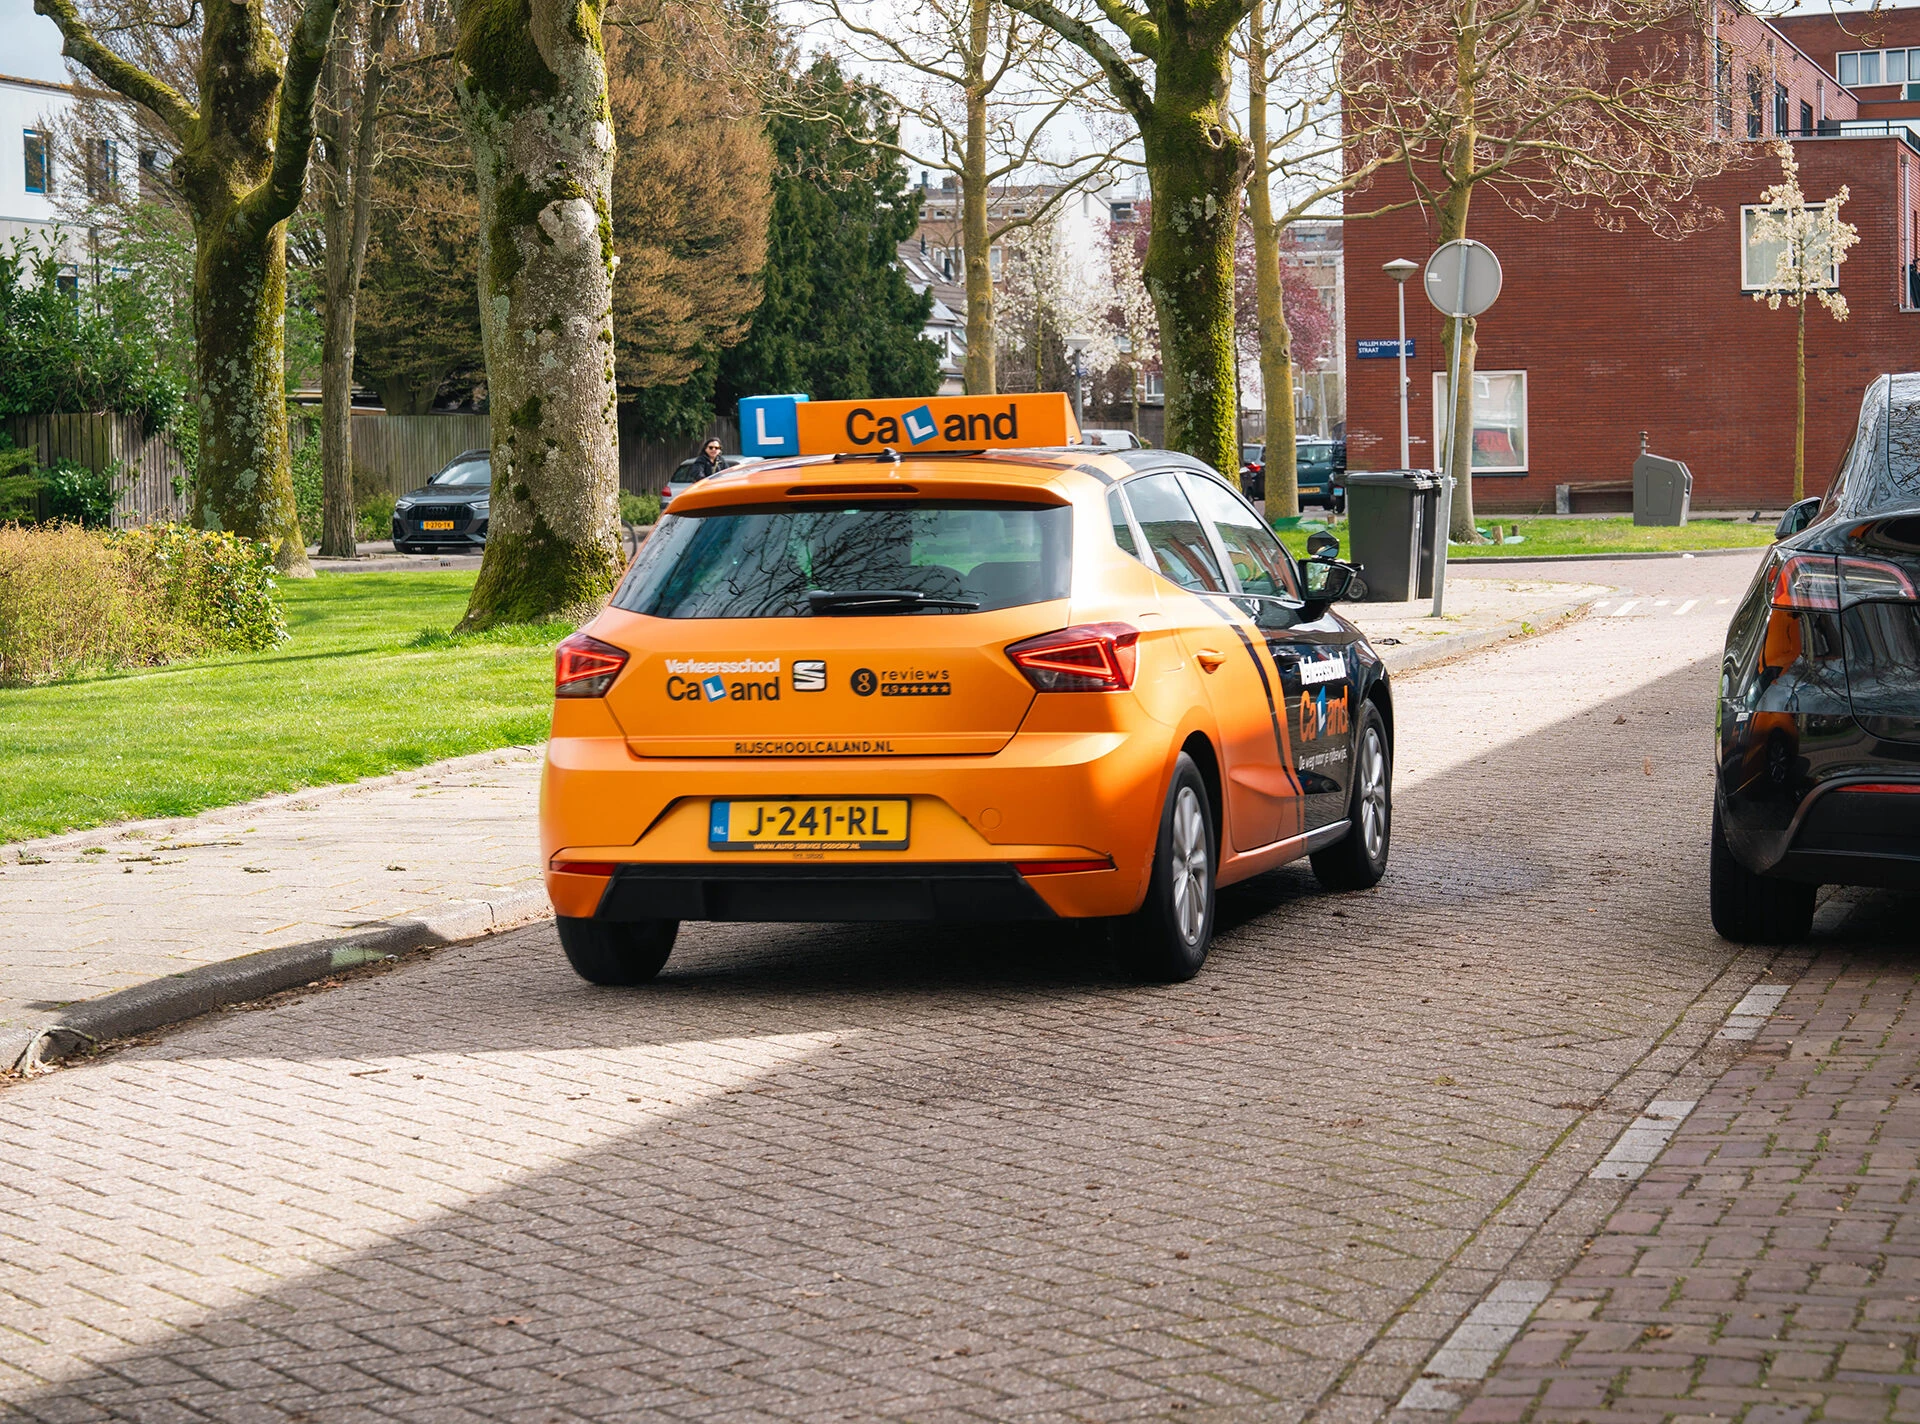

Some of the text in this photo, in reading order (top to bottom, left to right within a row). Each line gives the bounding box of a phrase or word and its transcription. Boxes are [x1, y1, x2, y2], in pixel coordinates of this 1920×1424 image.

[755, 407, 785, 446] L
[664, 657, 781, 674] Verkeersschool
[881, 667, 950, 681] reviews
[734, 741, 895, 754] RIJSCHOOLCALAND.NL
[748, 805, 889, 837] J-241-RL
